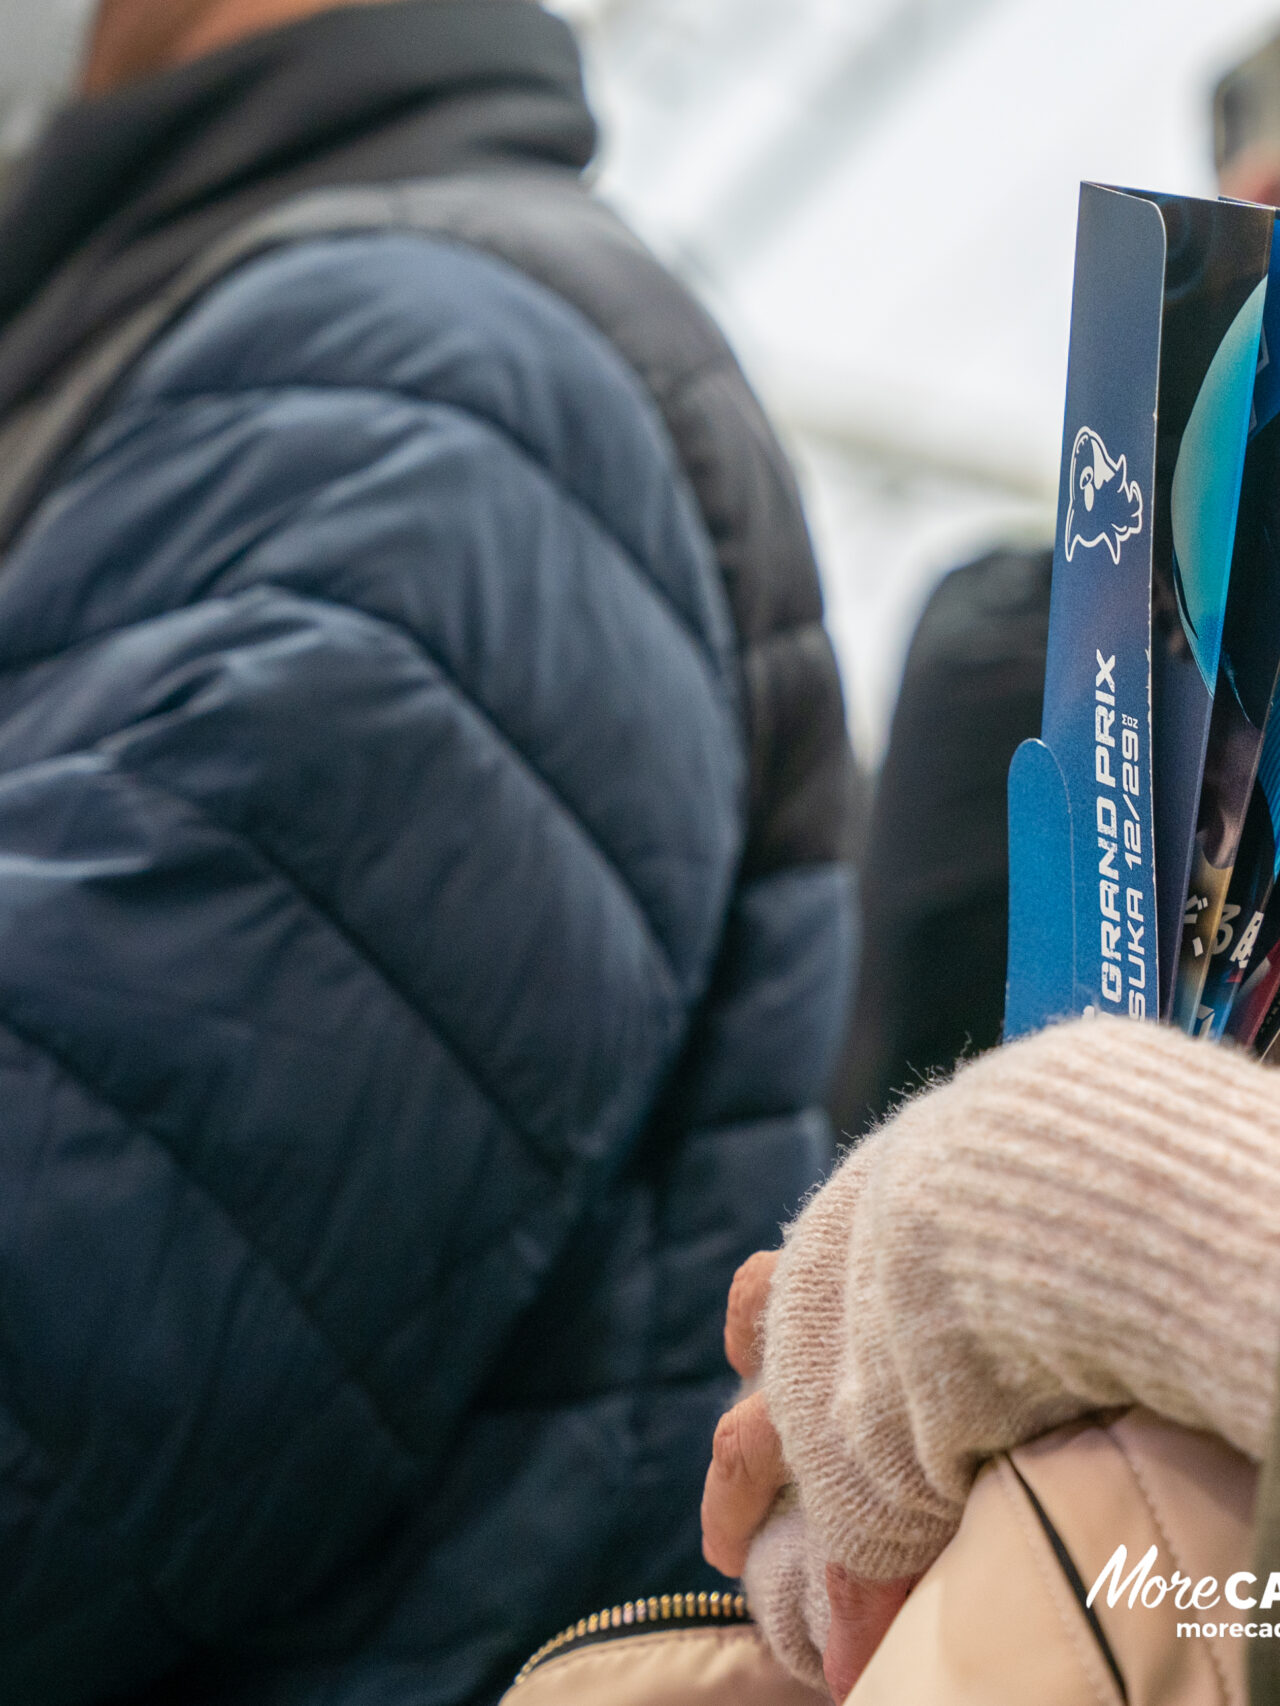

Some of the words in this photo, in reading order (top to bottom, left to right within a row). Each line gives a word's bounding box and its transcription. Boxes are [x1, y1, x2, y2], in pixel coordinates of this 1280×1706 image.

[1095, 648, 1117, 788] PRIX
[1121, 728, 1142, 871] 12/29
[1096, 797, 1122, 1003] GRAND
